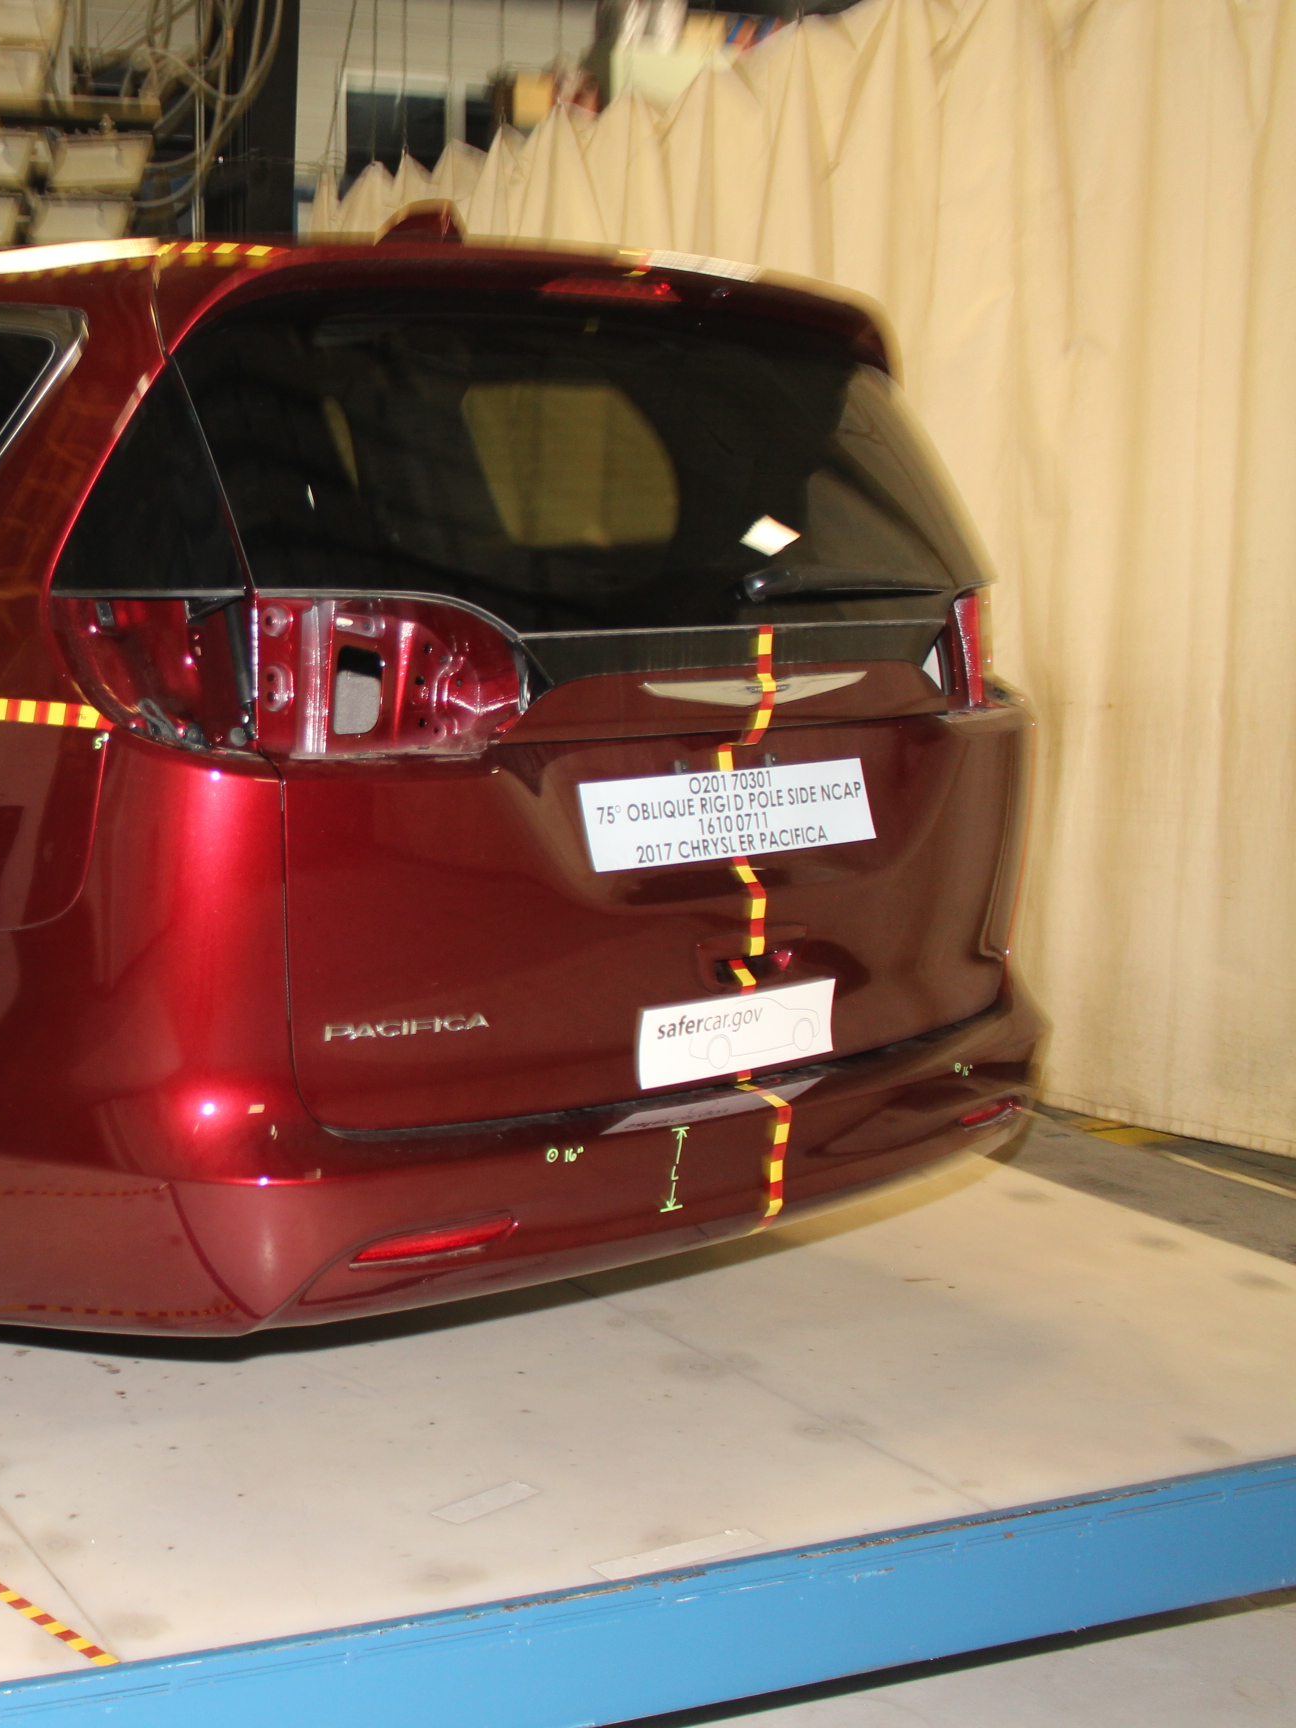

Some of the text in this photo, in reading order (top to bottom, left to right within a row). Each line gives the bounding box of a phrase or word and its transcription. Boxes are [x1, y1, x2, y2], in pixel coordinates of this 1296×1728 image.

[627, 798, 696, 822] OBLIQUE
[700, 794, 744, 816] RIGID
[749, 790, 784, 810] POLE
[788, 785, 817, 806] SIDE
[821, 781, 862, 801] NCAP
[636, 825, 828, 864] 2017 CHRYSLER PACIFICA
[324, 1012, 490, 1042] PACIFICA
[657, 1004, 764, 1041] safercar.gov
